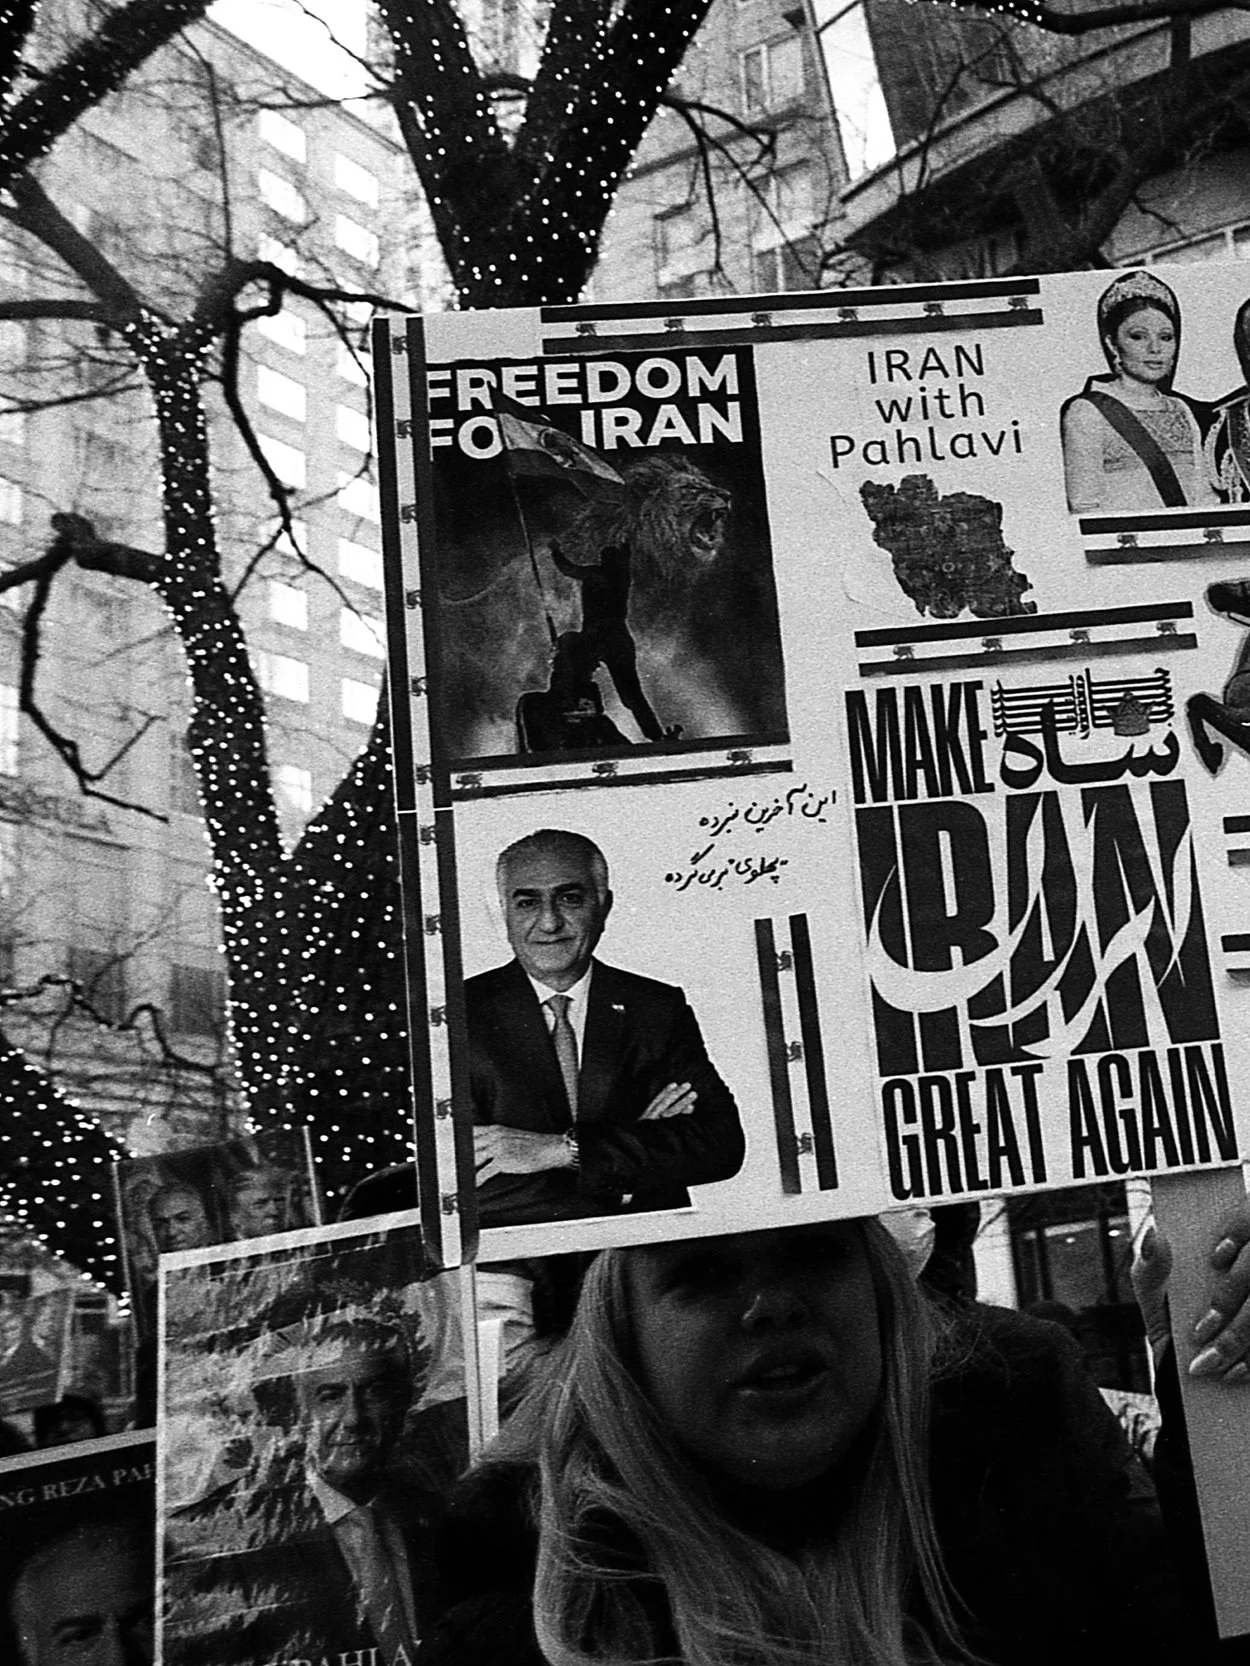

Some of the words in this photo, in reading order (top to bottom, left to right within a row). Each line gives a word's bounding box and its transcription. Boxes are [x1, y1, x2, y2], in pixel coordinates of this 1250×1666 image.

[426, 353, 740, 413] FREEDOM
[867, 343, 984, 385] IRAN
[428, 415, 503, 461] FO
[580, 401, 744, 450] IRAN
[874, 383, 985, 424] with
[829, 420, 1022, 469] Pahlavi
[845, 680, 996, 804] MAKE
[855, 779, 1221, 1078] IRAN
[881, 1063, 1047, 1201] GREAT
[1067, 1042, 1239, 1179] AGAIN
